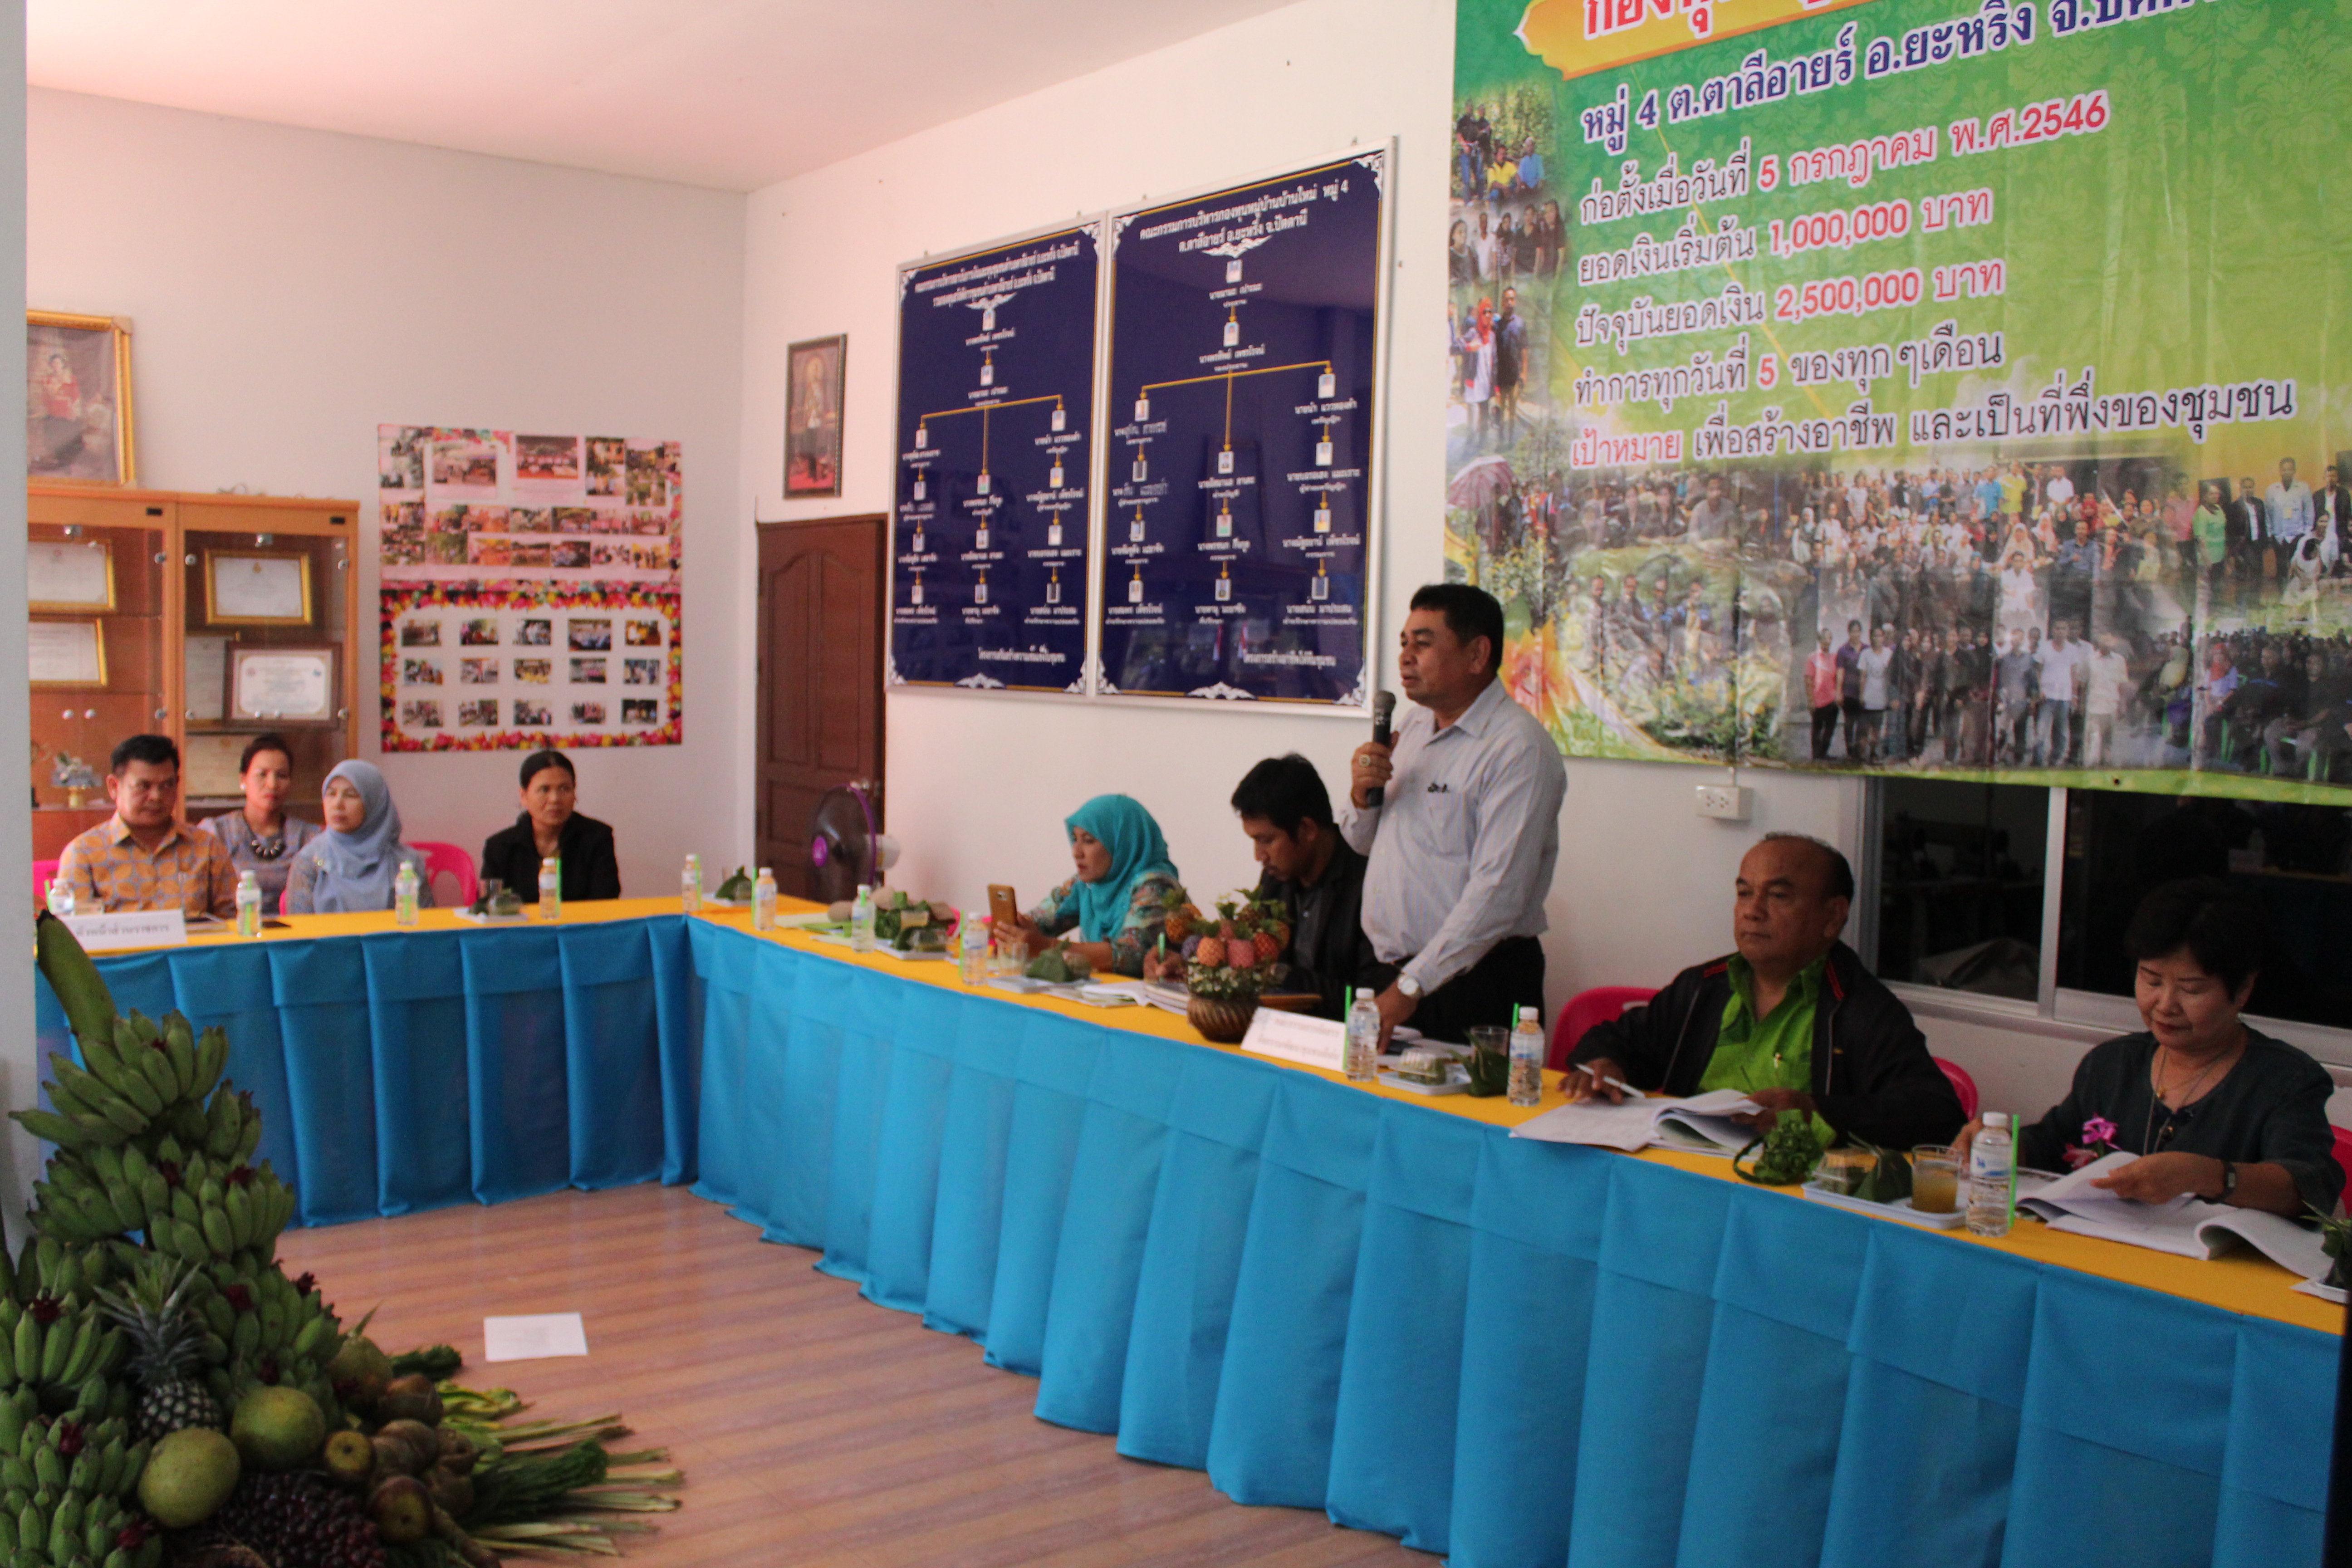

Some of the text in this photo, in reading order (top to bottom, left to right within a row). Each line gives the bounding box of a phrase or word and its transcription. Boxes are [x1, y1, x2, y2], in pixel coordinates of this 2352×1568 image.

[1584, 88, 1626, 152] หมู่
[1640, 93, 1656, 126] 4
[1671, 26, 1853, 120] ต.ตาลีอายร์
[1340, 179, 1350, 193] 4
[1582, 94, 2106, 222] ก่อตั้งเมื่อวันที่ 5 กรกฎาคม พ.ศ.2546
[1581, 192, 1989, 283] ยอดเงินเริ่มต้น 1,000,000 บาท
[1577, 263, 2001, 353] ปัจจุบันยอดเงิน 2,500,000 บาท
[1576, 336, 1746, 409] ทำการทุกวันที่
[1758, 357, 1775, 386] 5
[1572, 428, 1681, 466] เป้าหมาย
[1695, 403, 1895, 455] เพื่อสร้างอาชีพ
